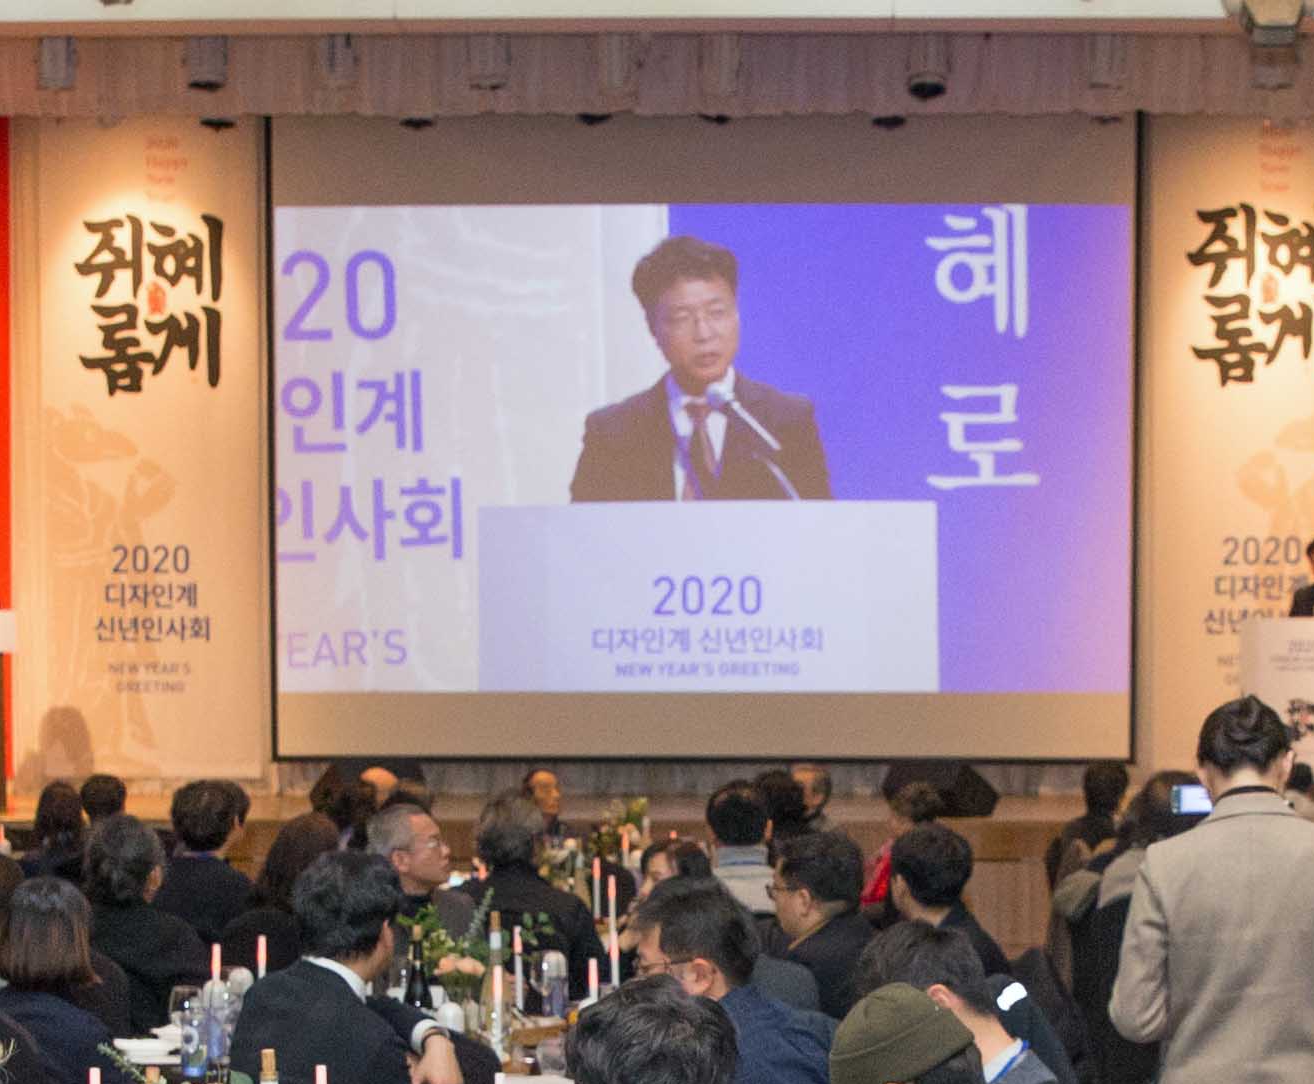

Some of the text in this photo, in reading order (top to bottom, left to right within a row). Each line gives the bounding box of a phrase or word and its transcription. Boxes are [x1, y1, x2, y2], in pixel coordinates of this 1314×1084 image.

[280, 250, 398, 342] 20
[280, 369, 424, 454] 인계
[111, 544, 191, 574] 2020
[1222, 536, 1302, 566] 2020
[104, 582, 199, 609] 디자인계
[652, 575, 764, 617] 2020
[95, 616, 212, 642] 신년인사회
[590, 626, 825, 654] 디자인계 신년인사회
[278, 628, 408, 670] EAR'S
